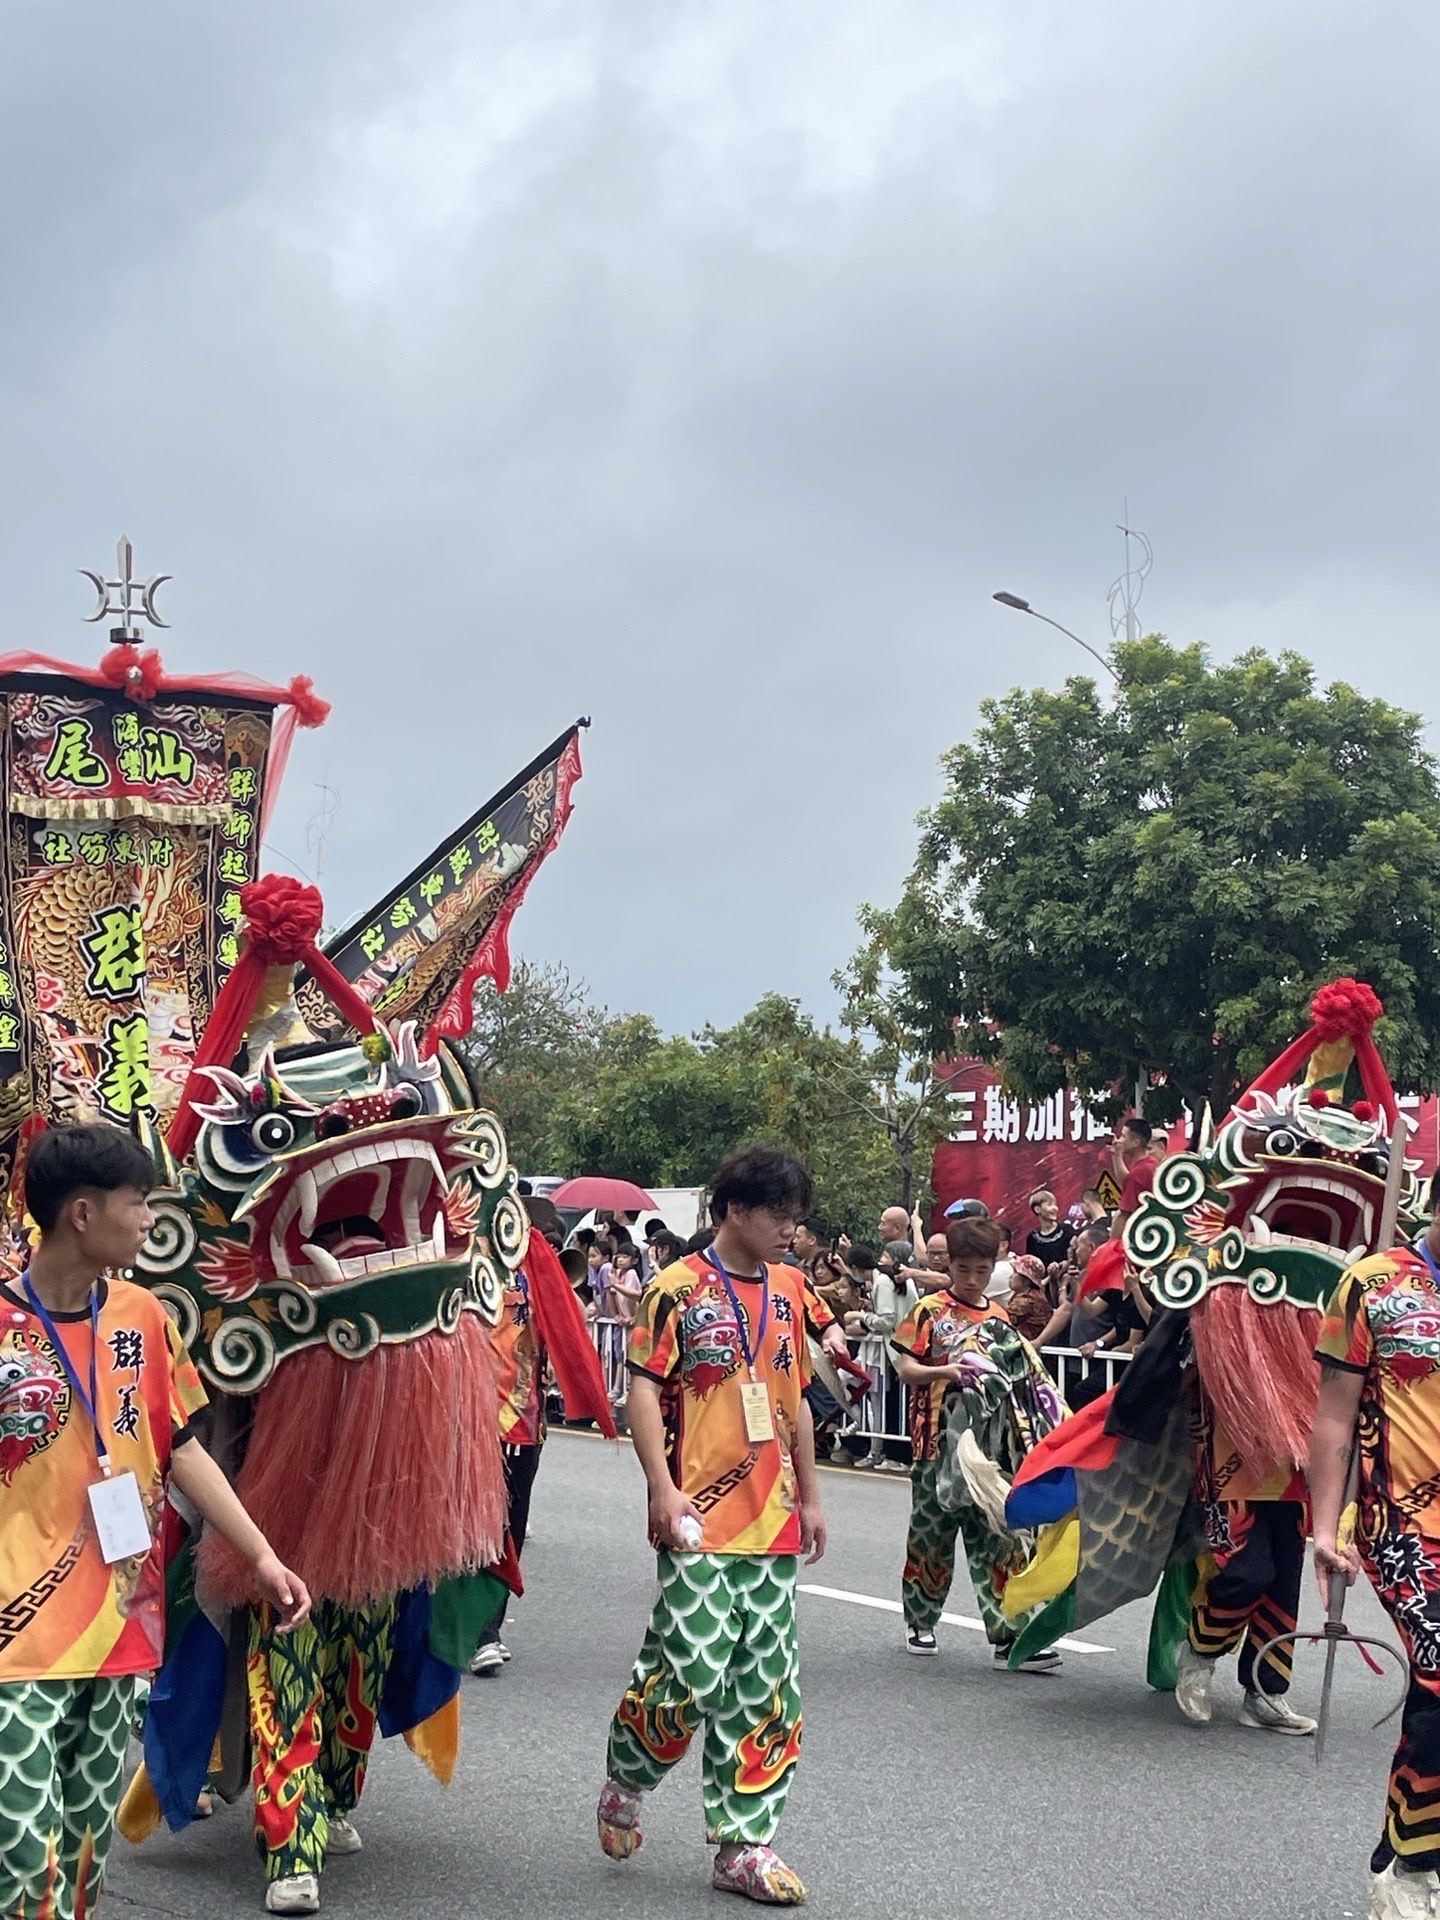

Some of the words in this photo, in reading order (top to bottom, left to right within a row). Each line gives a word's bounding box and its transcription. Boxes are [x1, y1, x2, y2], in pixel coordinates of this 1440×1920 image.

[44, 832, 173, 867] 附東笏社
[107, 1329, 145, 1442] 群義
